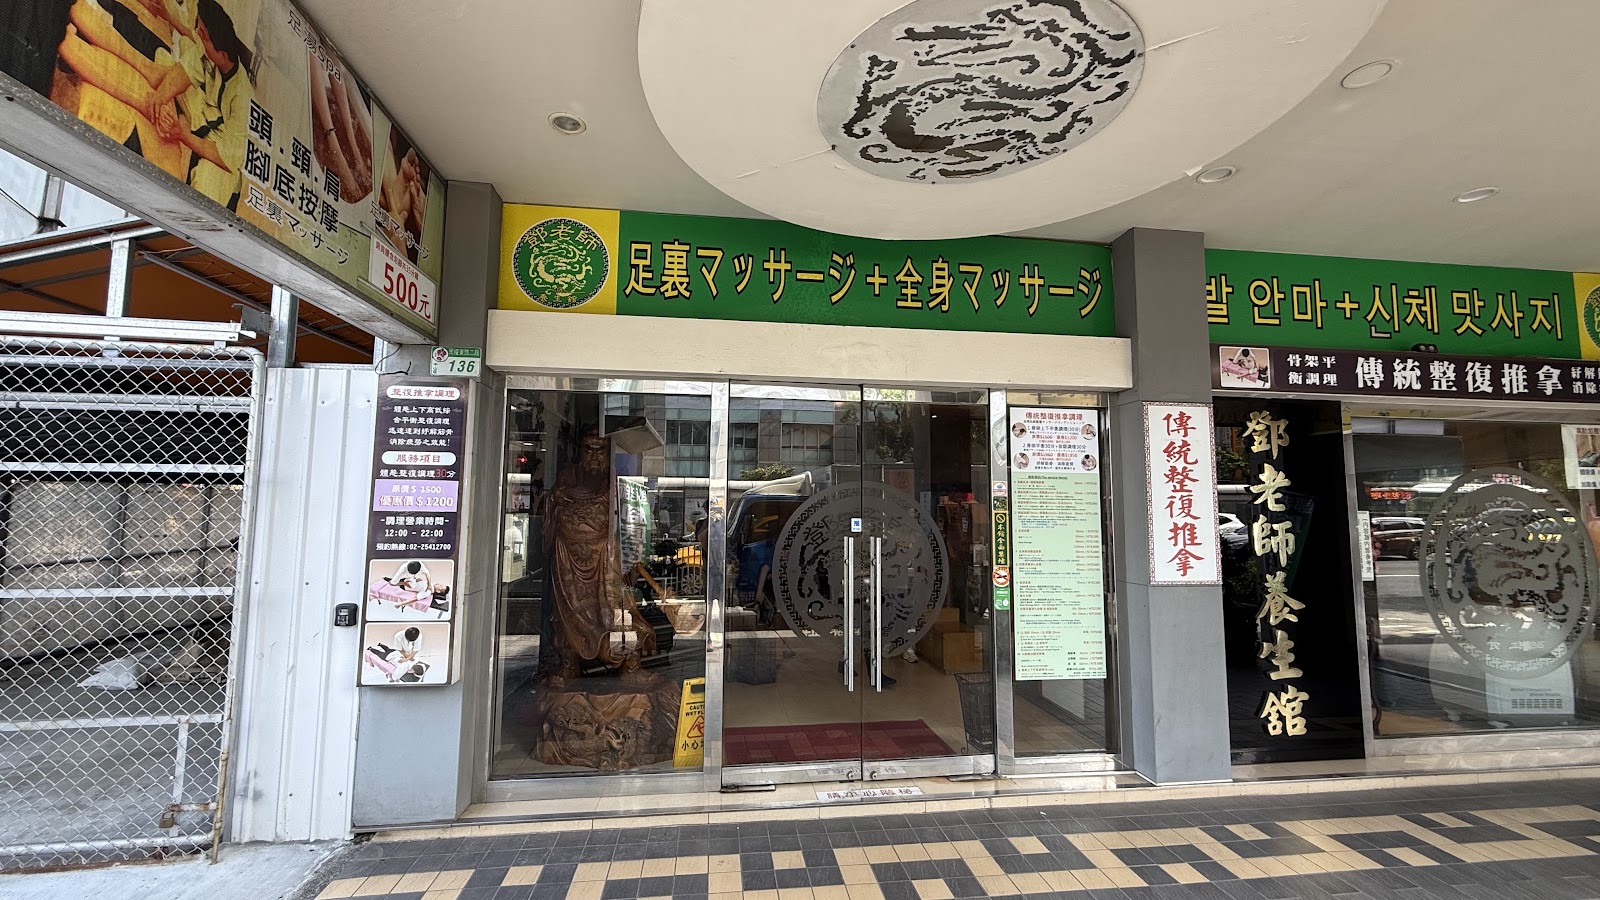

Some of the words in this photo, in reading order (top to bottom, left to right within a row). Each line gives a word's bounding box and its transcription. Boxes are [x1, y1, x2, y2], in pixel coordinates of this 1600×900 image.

[244, 138, 339, 234] 腳底按摩
[247, 186, 349, 265] 足裏マッサージ
[523, 223, 601, 251] 鄧老師
[383, 261, 431, 319] 500元
[1451, 286, 1565, 341] 맛사지
[449, 360, 476, 373] 136
[1286, 353, 1337, 369] 骨架平
[1288, 371, 1339, 387] 衡調理
[1355, 356, 1564, 396] 傳統整復推拿
[391, 388, 455, 398] 整復推拿調理
[1572, 381, 1600, 395] 消除
[393, 416, 450, 426] 合平衡整復調理
[396, 454, 441, 463] 服務項目
[419, 485, 442, 494] 1500
[1162, 410, 1205, 577] 傳統整復推拿
[379, 495, 414, 507] 優惠價
[425, 496, 453, 507] 1200
[384, 529, 408, 537] 12:00
[420, 529, 444, 537] 22:00
[1242, 410, 1310, 737] 鄧老師養生館
